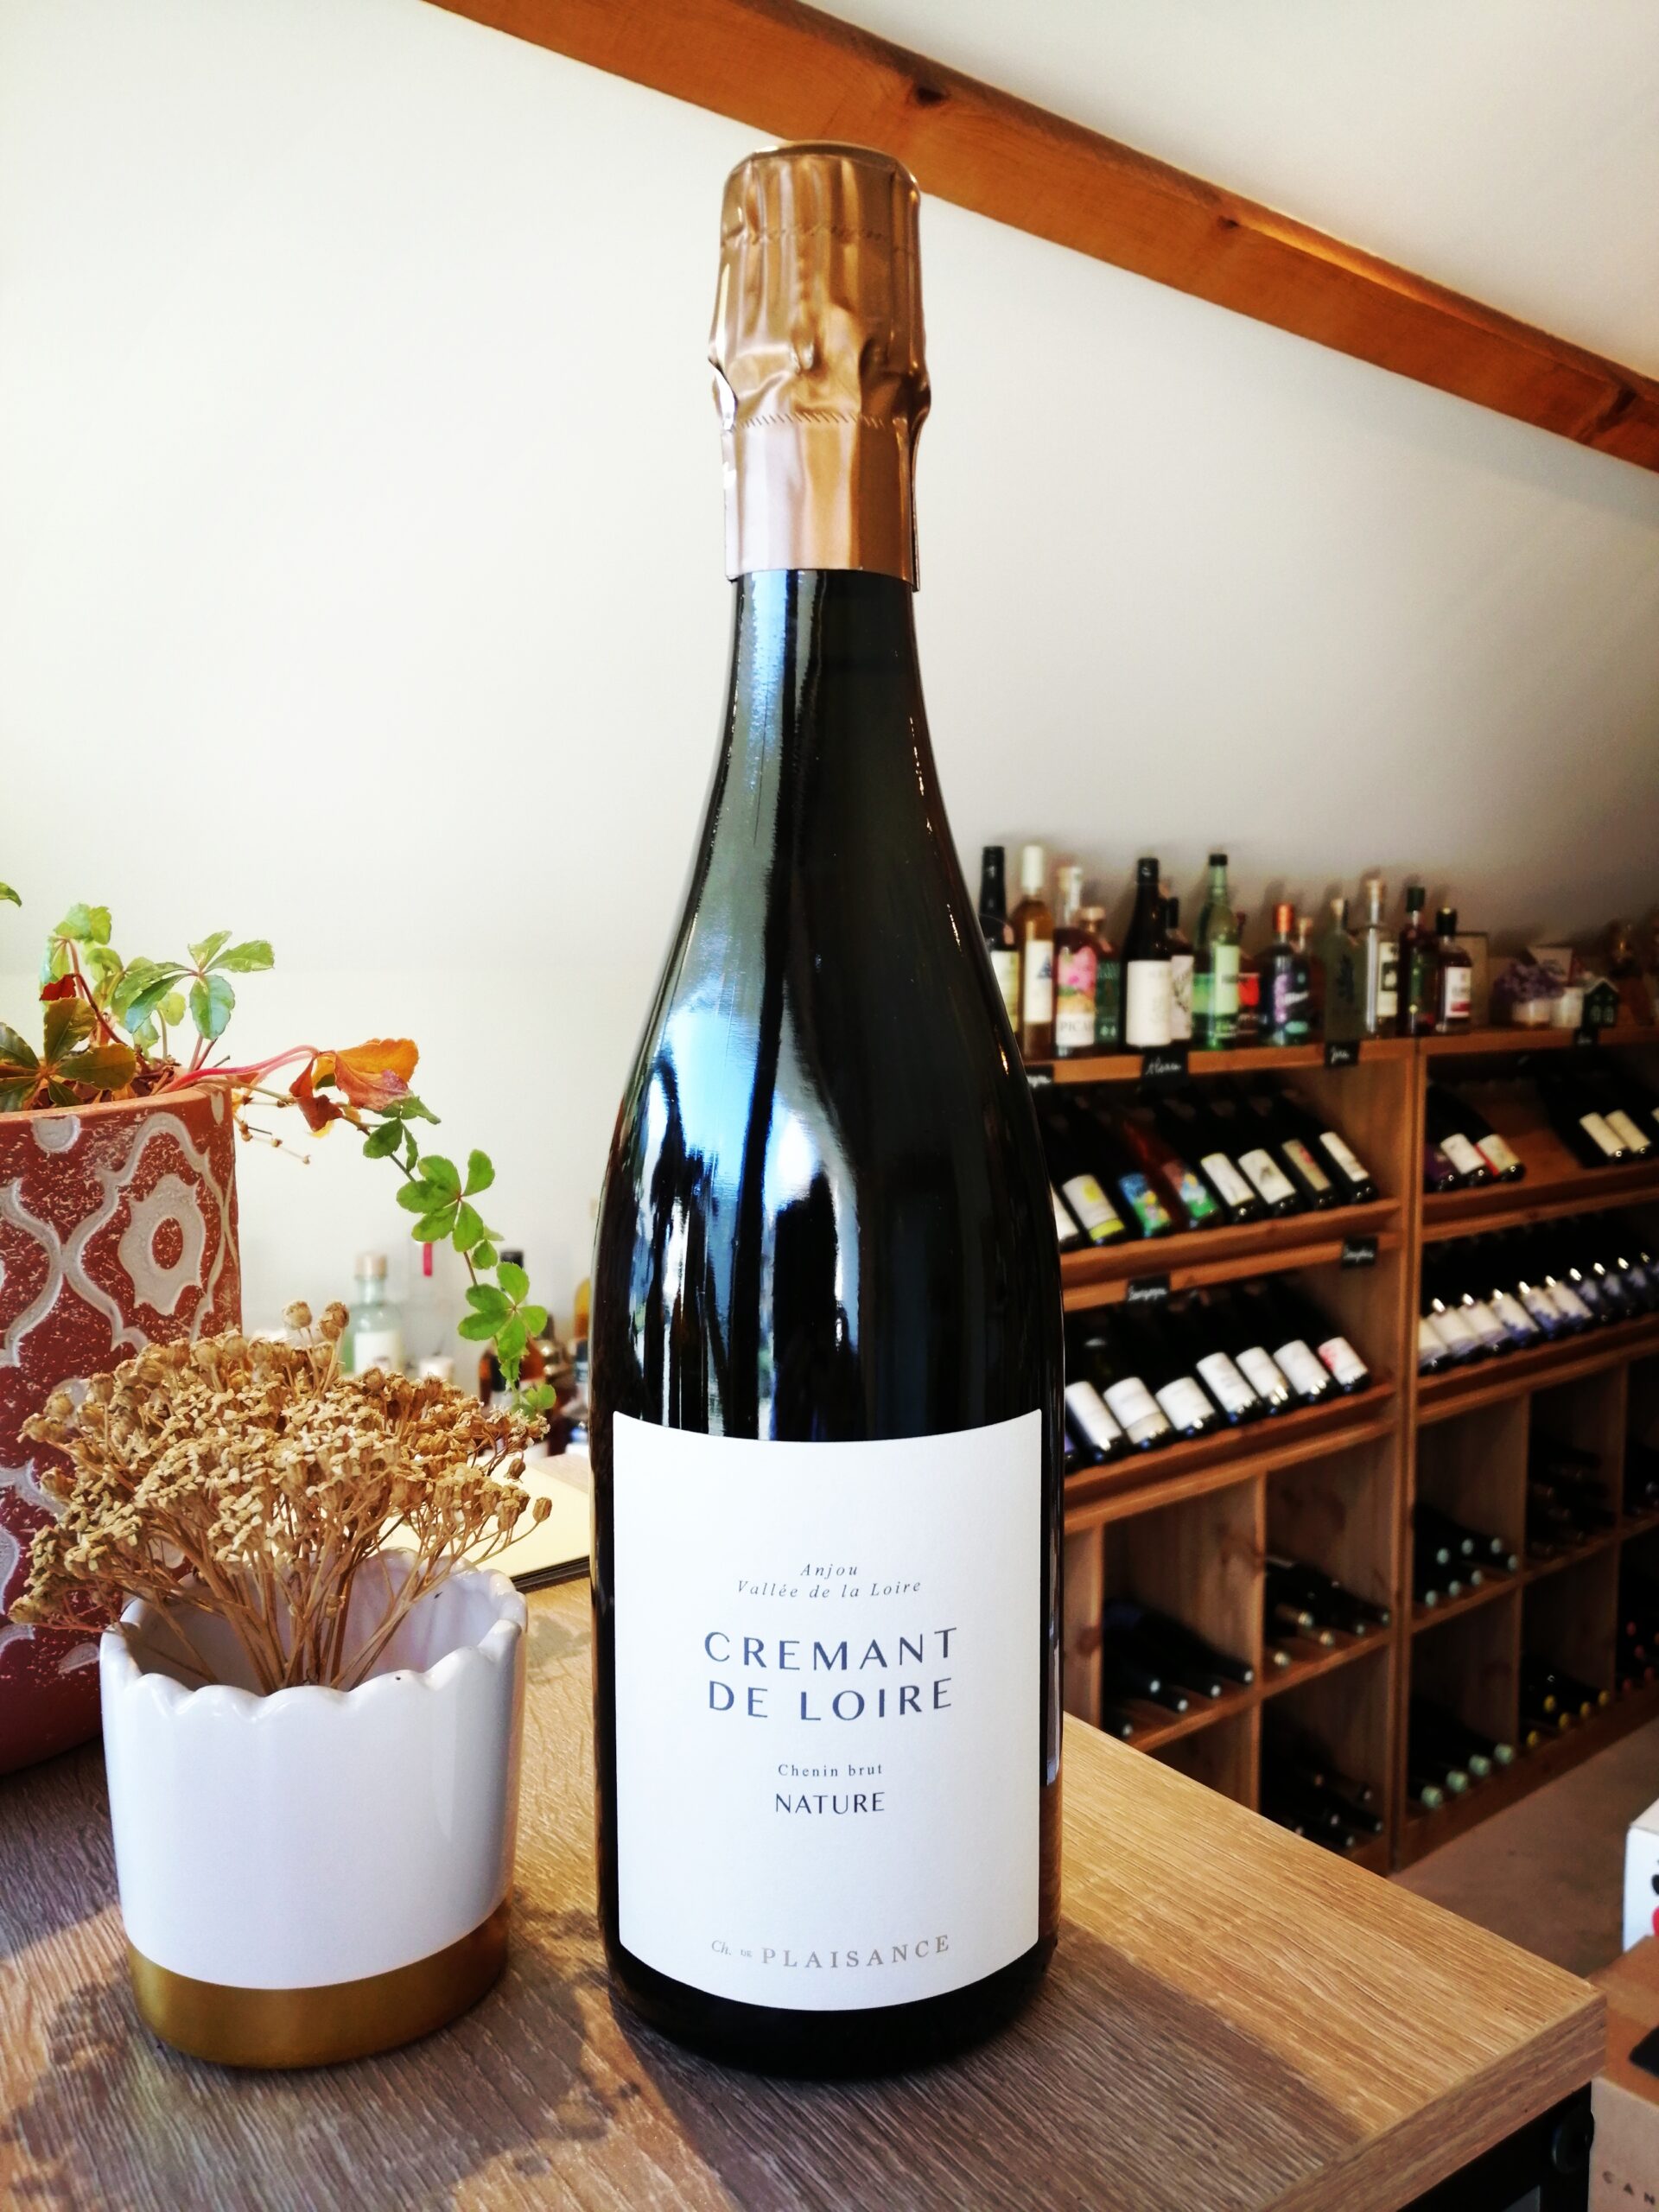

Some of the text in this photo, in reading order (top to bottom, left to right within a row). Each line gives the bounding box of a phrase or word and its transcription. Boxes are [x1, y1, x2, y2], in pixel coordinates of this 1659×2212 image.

[799, 1563, 858, 1580] Anjou
[738, 1580, 921, 1598] Vallée de la Loire
[704, 1627, 957, 1671] CREMANT
[709, 1677, 952, 1721] DE LOIRE
[778, 1764, 883, 1777] Chenin brut
[775, 1791, 886, 1815] NATURE
[711, 1939, 732, 1956] Ch.
[761, 1934, 950, 1969] PLAISANCE
